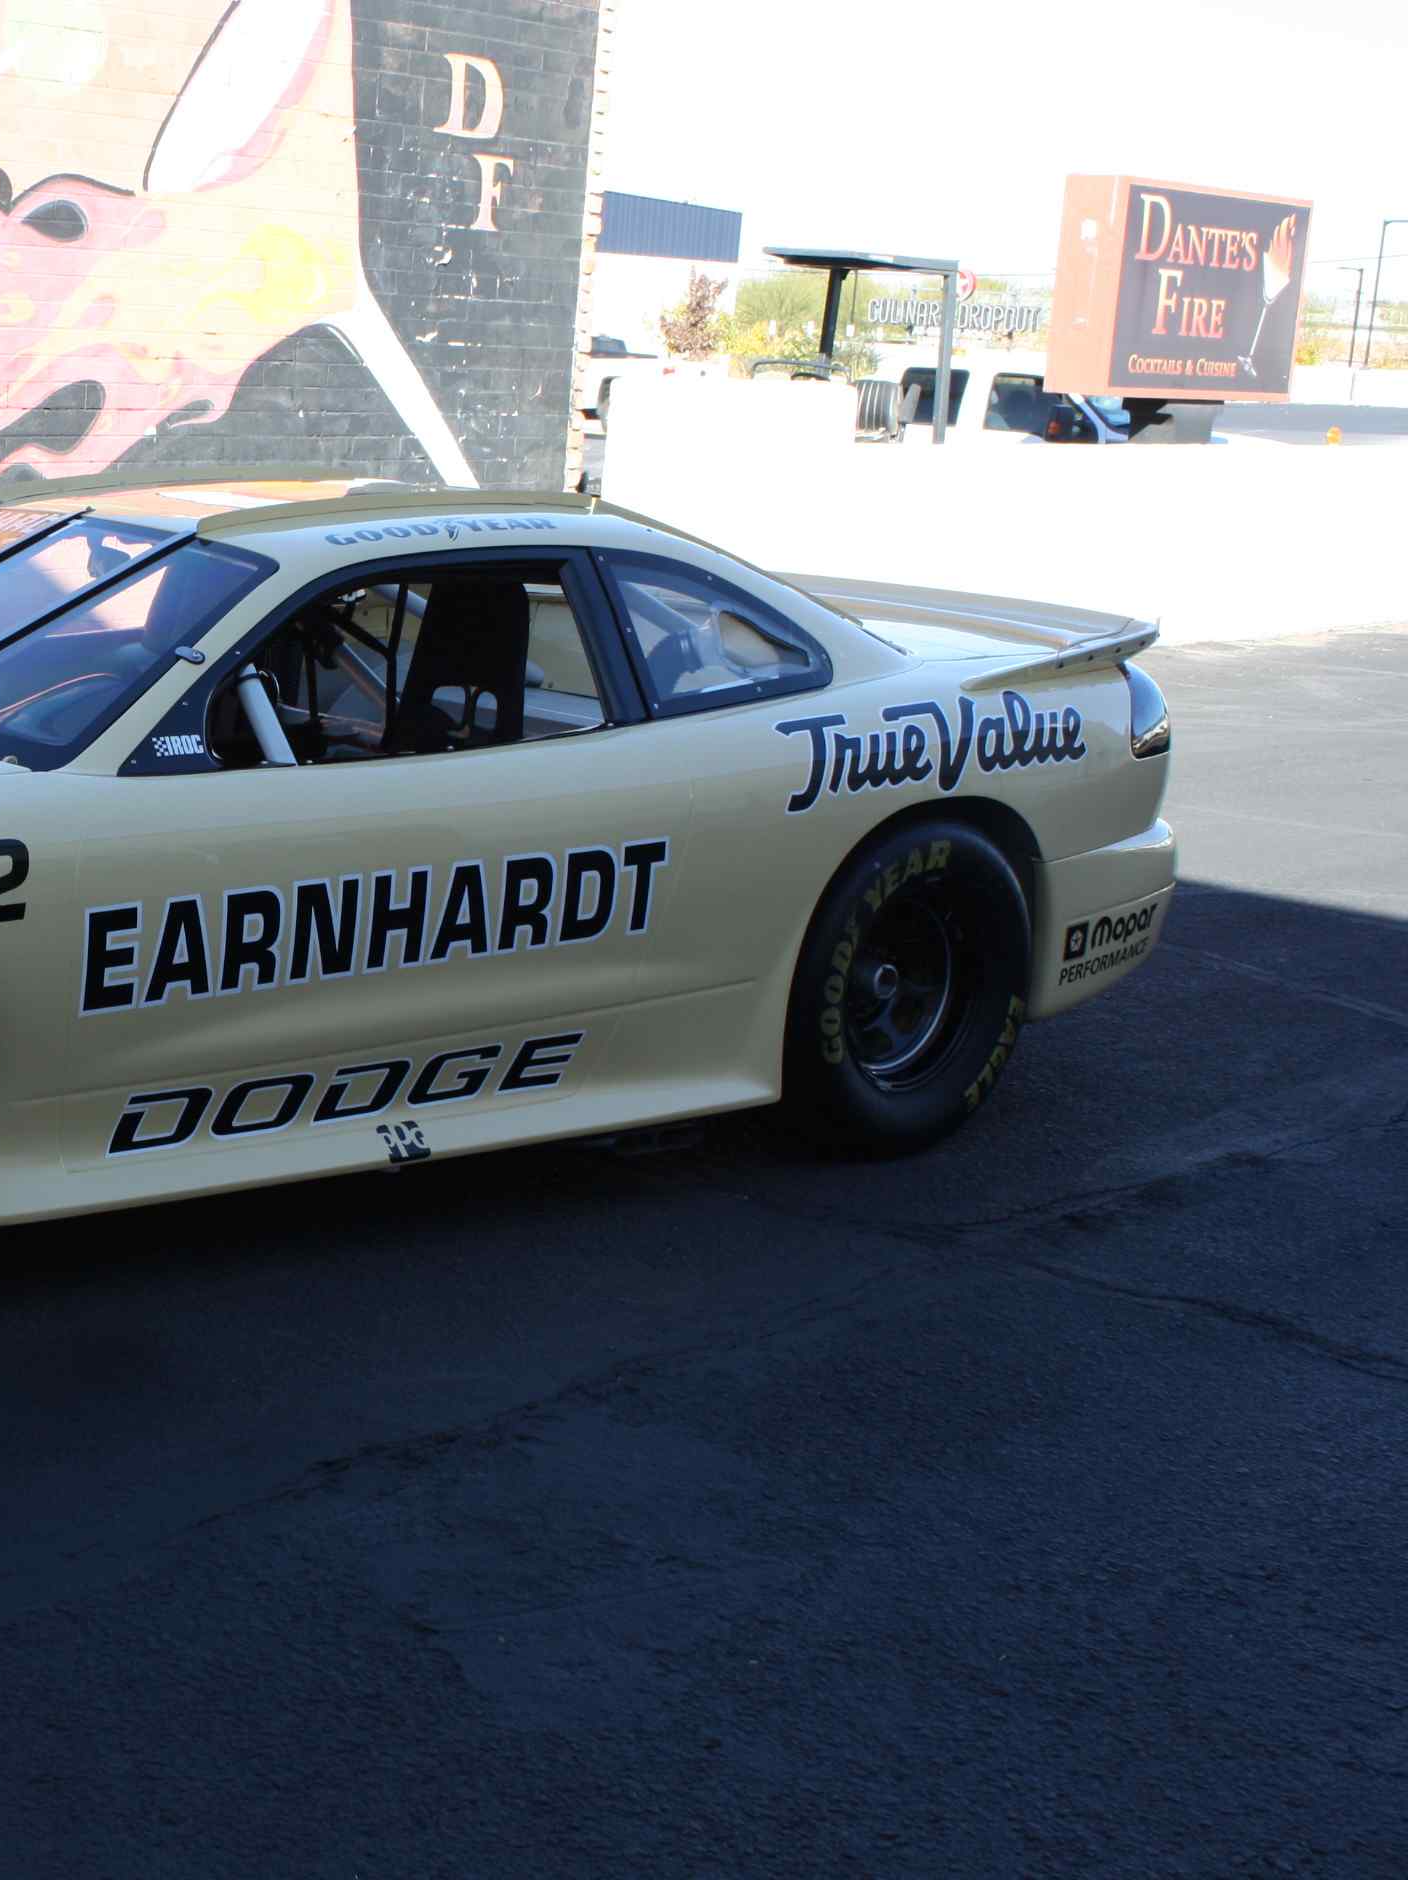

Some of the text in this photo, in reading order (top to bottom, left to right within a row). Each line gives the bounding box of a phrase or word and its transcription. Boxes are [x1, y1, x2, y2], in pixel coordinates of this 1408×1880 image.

[433, 52, 503, 139] D
[471, 153, 514, 231] F
[867, 298, 1043, 333] CULINAR DROPOUT
[1152, 268, 1226, 339] FIRE
[1185, 359, 1194, 376] &
[164, 734, 205, 756] IROC
[78, 836, 670, 1018] EARNHARDT
[1058, 936, 1151, 986] PERFORMANCE
[105, 1031, 586, 1158] DODGE
[376, 1121, 431, 1162] PPG
